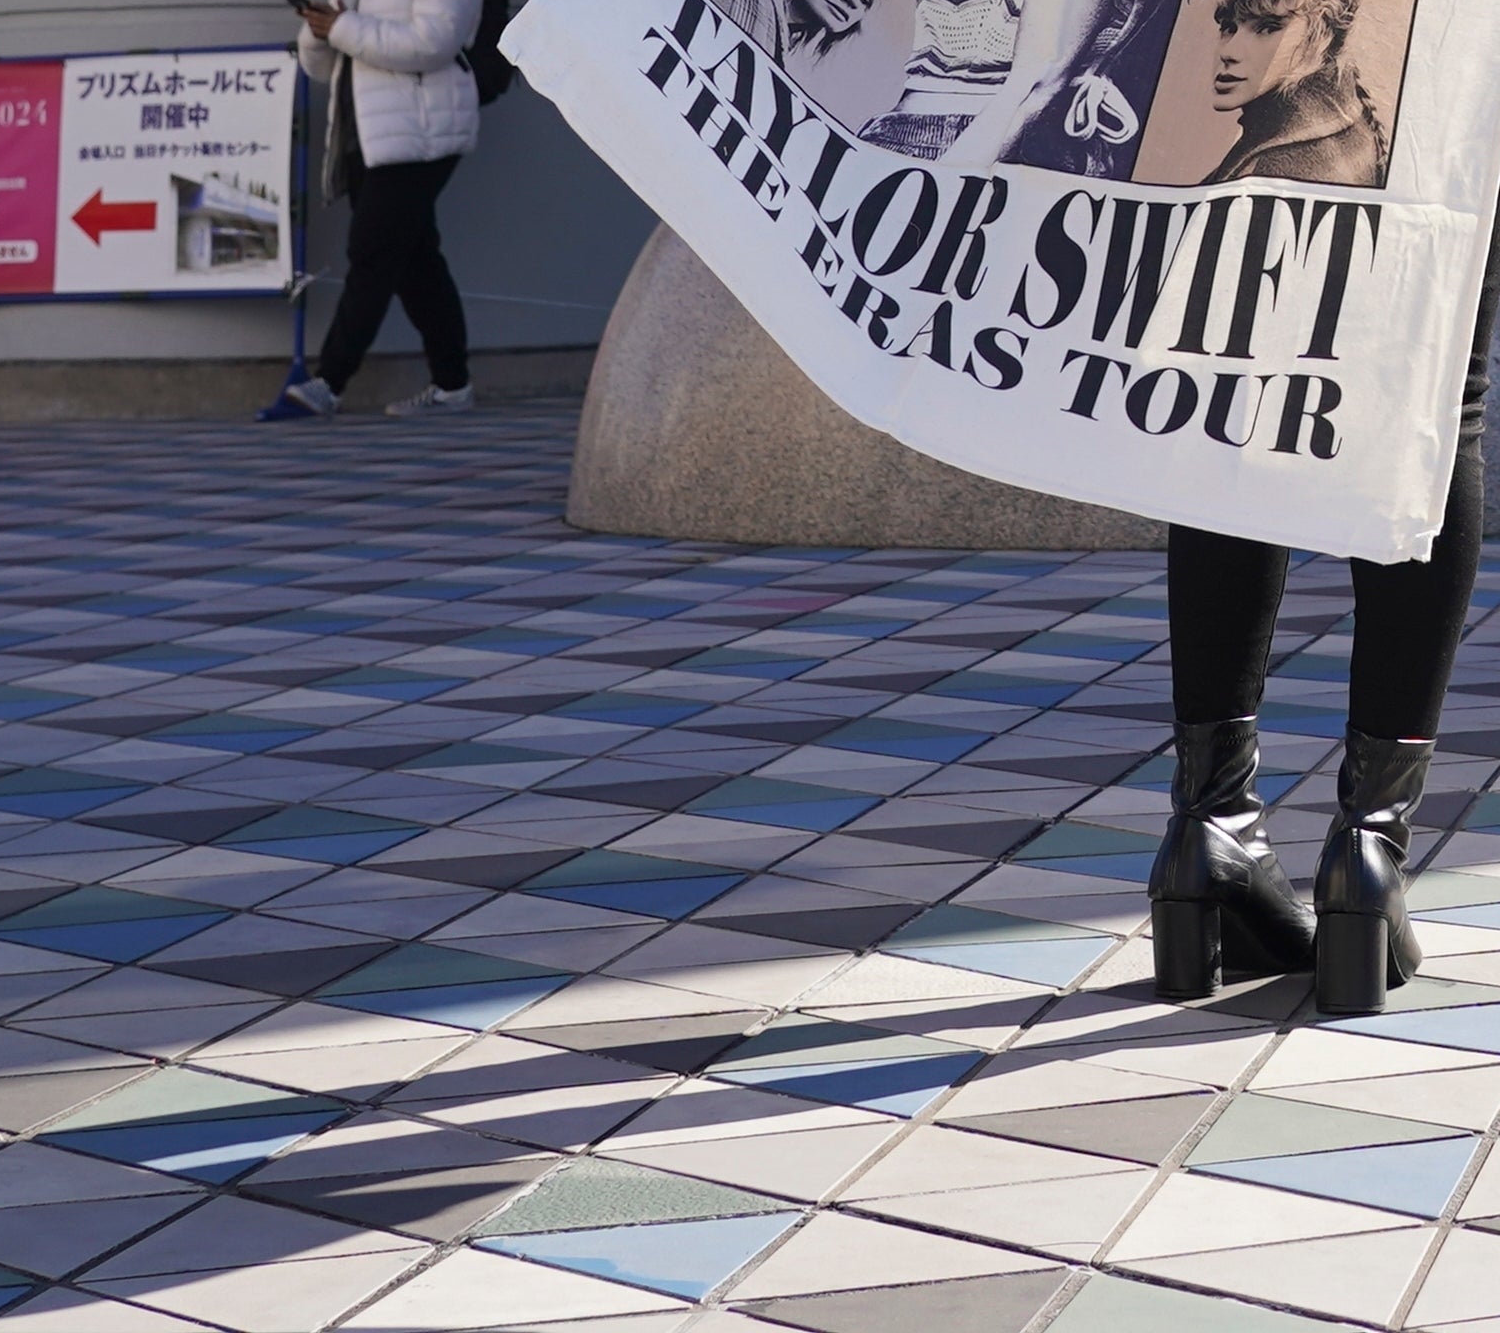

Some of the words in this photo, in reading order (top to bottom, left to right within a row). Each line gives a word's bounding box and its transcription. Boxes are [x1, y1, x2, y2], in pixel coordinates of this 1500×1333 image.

[141, 102, 209, 130] 開催中
[638, 26, 791, 221] THE
[795, 216, 1029, 391] ERAS
[1060, 349, 1344, 460] TOUR
[1009, 189, 1380, 361] SWIFT
